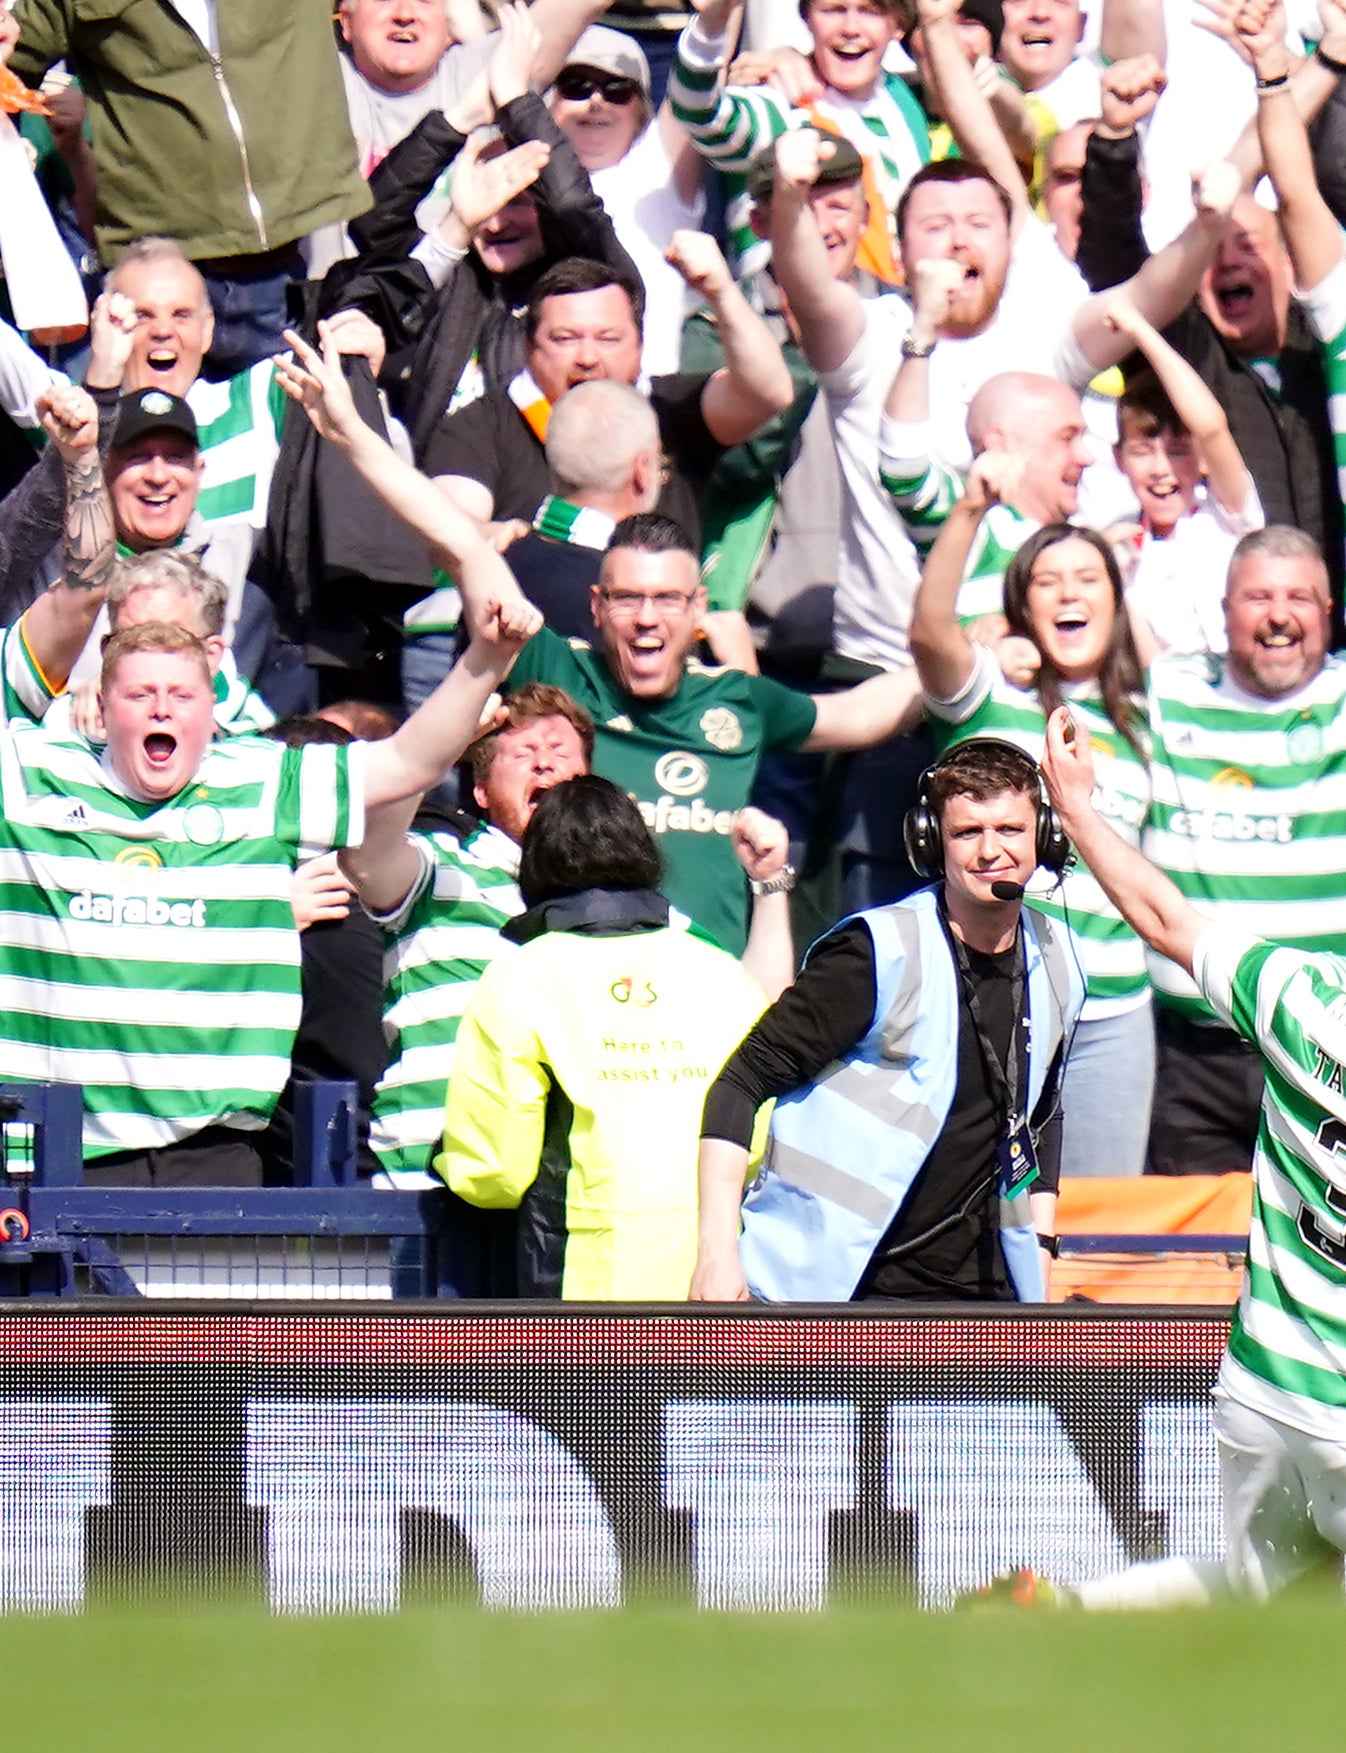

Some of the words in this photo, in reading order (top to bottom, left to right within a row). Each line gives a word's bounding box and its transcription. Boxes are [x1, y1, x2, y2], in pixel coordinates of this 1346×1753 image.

[68, 889, 207, 928] dafabet
[602, 1037, 651, 1054] Here
[660, 1040, 684, 1053] to
[596, 1066, 660, 1081] assist
[669, 1066, 708, 1084] you
